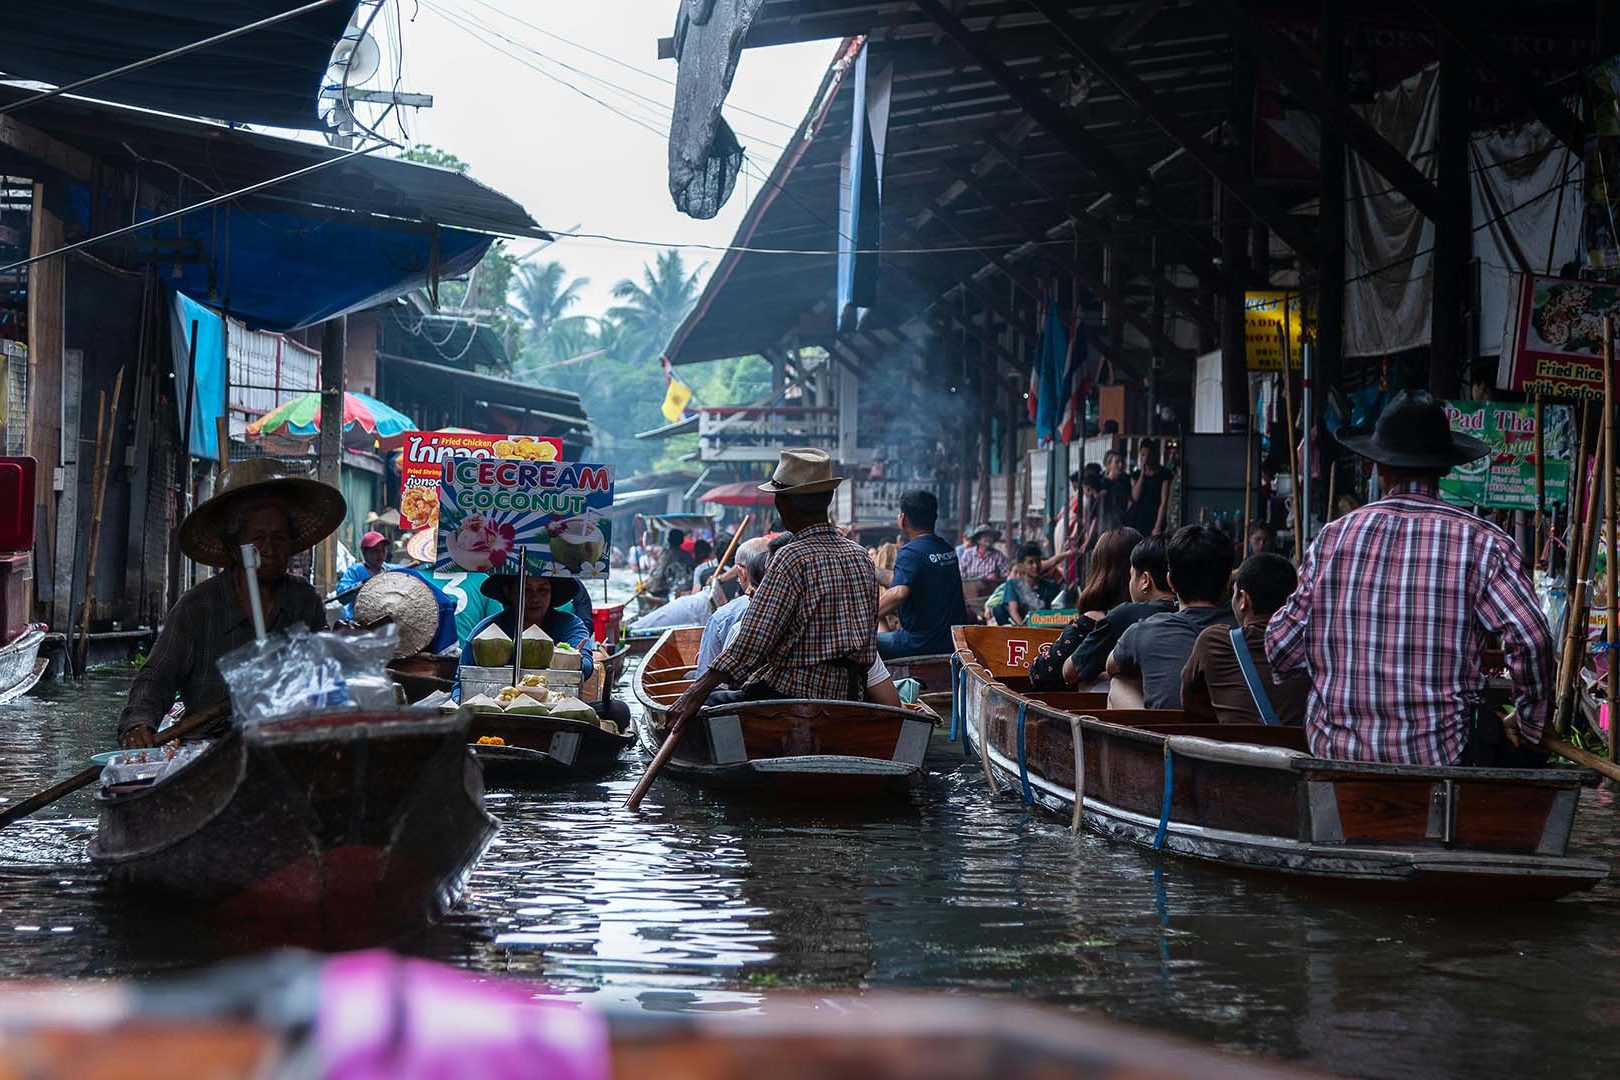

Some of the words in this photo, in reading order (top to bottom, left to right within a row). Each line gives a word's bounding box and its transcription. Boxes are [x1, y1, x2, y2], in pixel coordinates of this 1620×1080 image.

[1537, 360, 1573, 378] Fried
[1575, 363, 1604, 381] Rice
[1557, 383, 1605, 401] Seafoo
[1445, 407, 1485, 431] Pad
[1494, 408, 1537, 433] Tha
[441, 437, 462, 446] Fried
[462, 438, 493, 447] Chicken
[445, 461, 611, 492] ICECREAM
[457, 488, 587, 514] COCONUT
[433, 571, 468, 615] 3
[1006, 639, 1030, 668] F.
